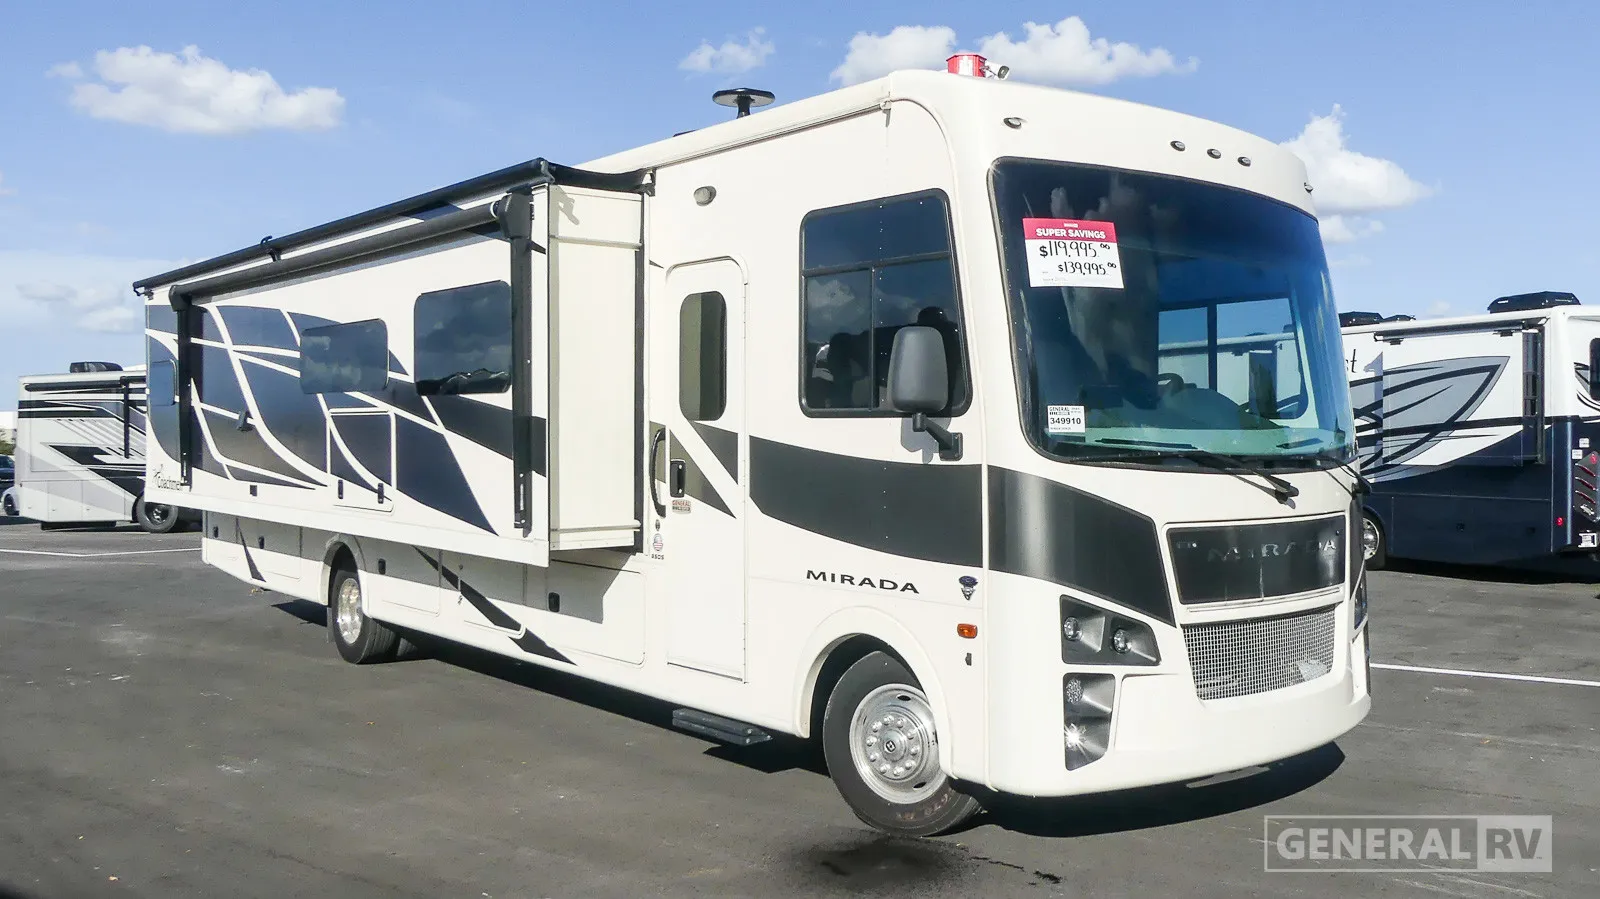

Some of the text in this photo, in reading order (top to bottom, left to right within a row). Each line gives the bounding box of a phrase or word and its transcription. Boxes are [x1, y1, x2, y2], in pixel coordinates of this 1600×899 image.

[1036, 228, 1106, 239] SUPER SAVINGS
[1050, 417, 1082, 425] 349910
[806, 569, 919, 594] MIRADA
